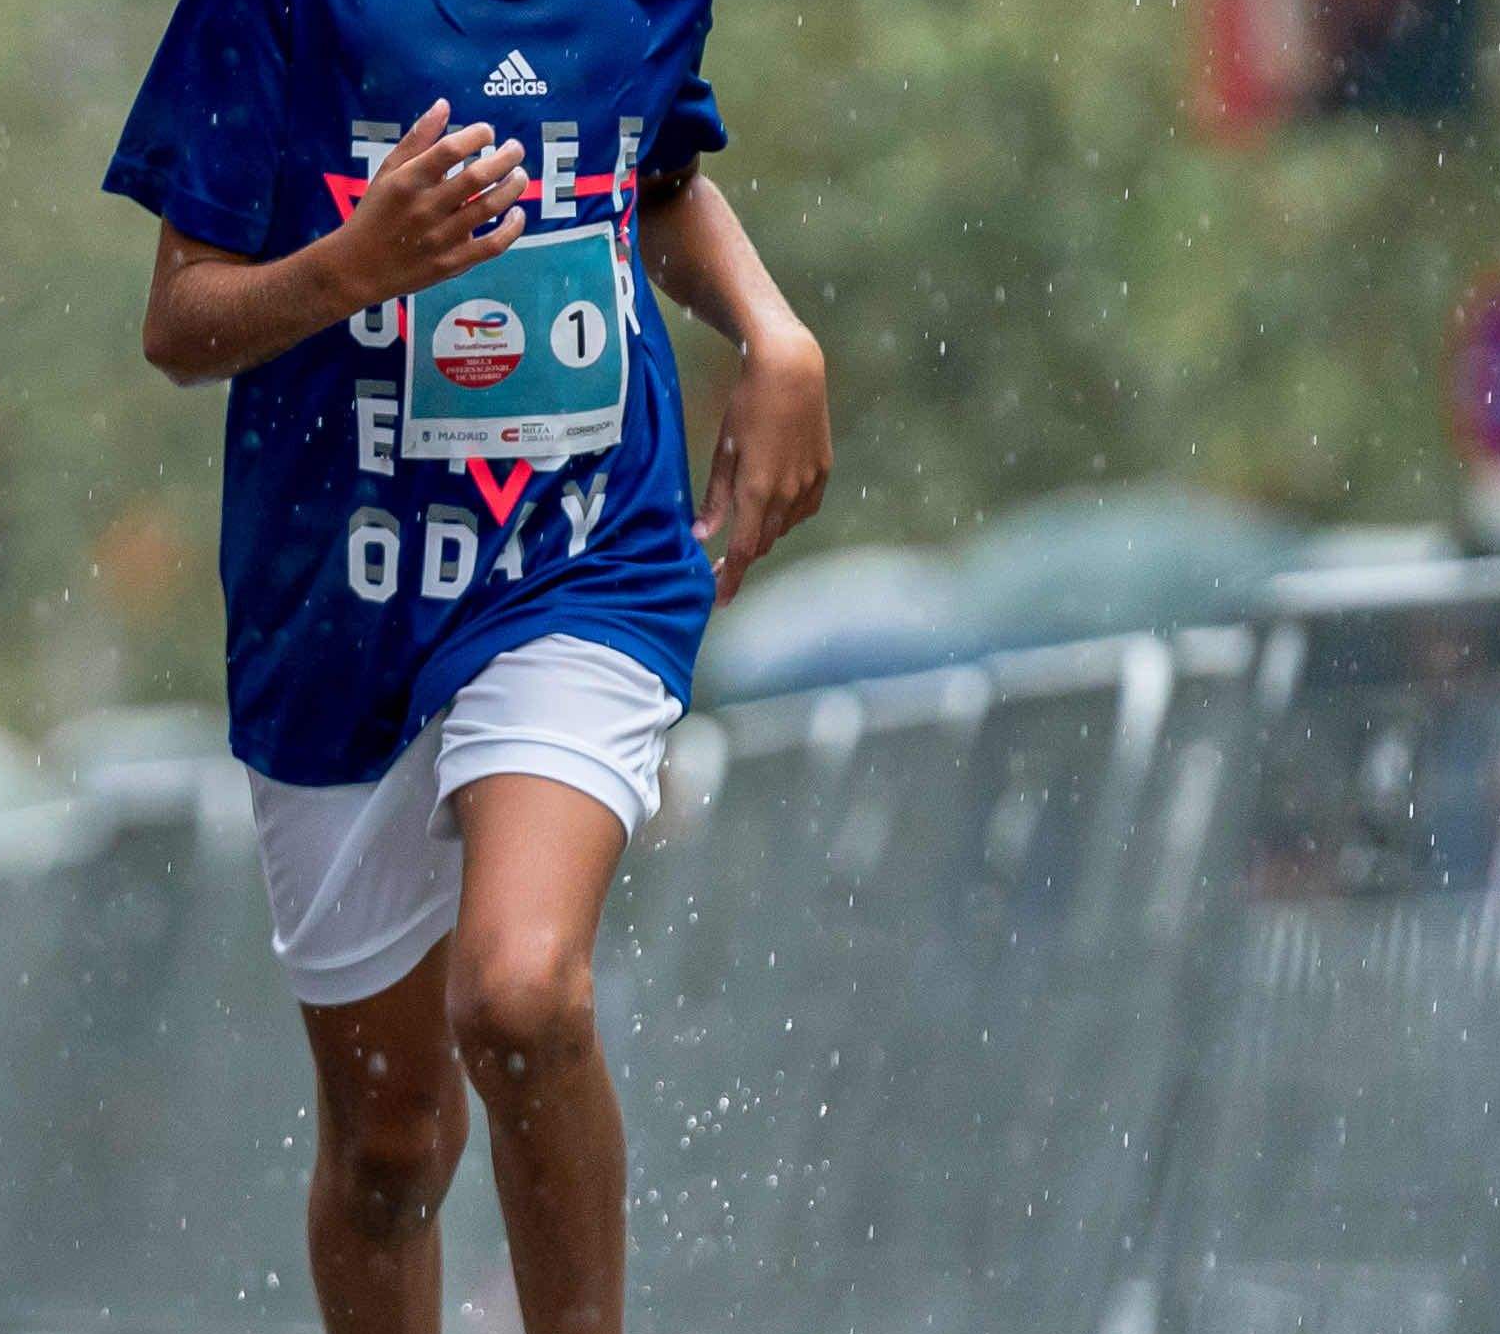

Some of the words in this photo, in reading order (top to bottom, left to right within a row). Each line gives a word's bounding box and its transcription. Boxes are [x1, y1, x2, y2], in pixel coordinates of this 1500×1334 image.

[484, 78, 548, 96] adidas
[568, 310, 586, 359] 1
[438, 431, 489, 441] MADRID
